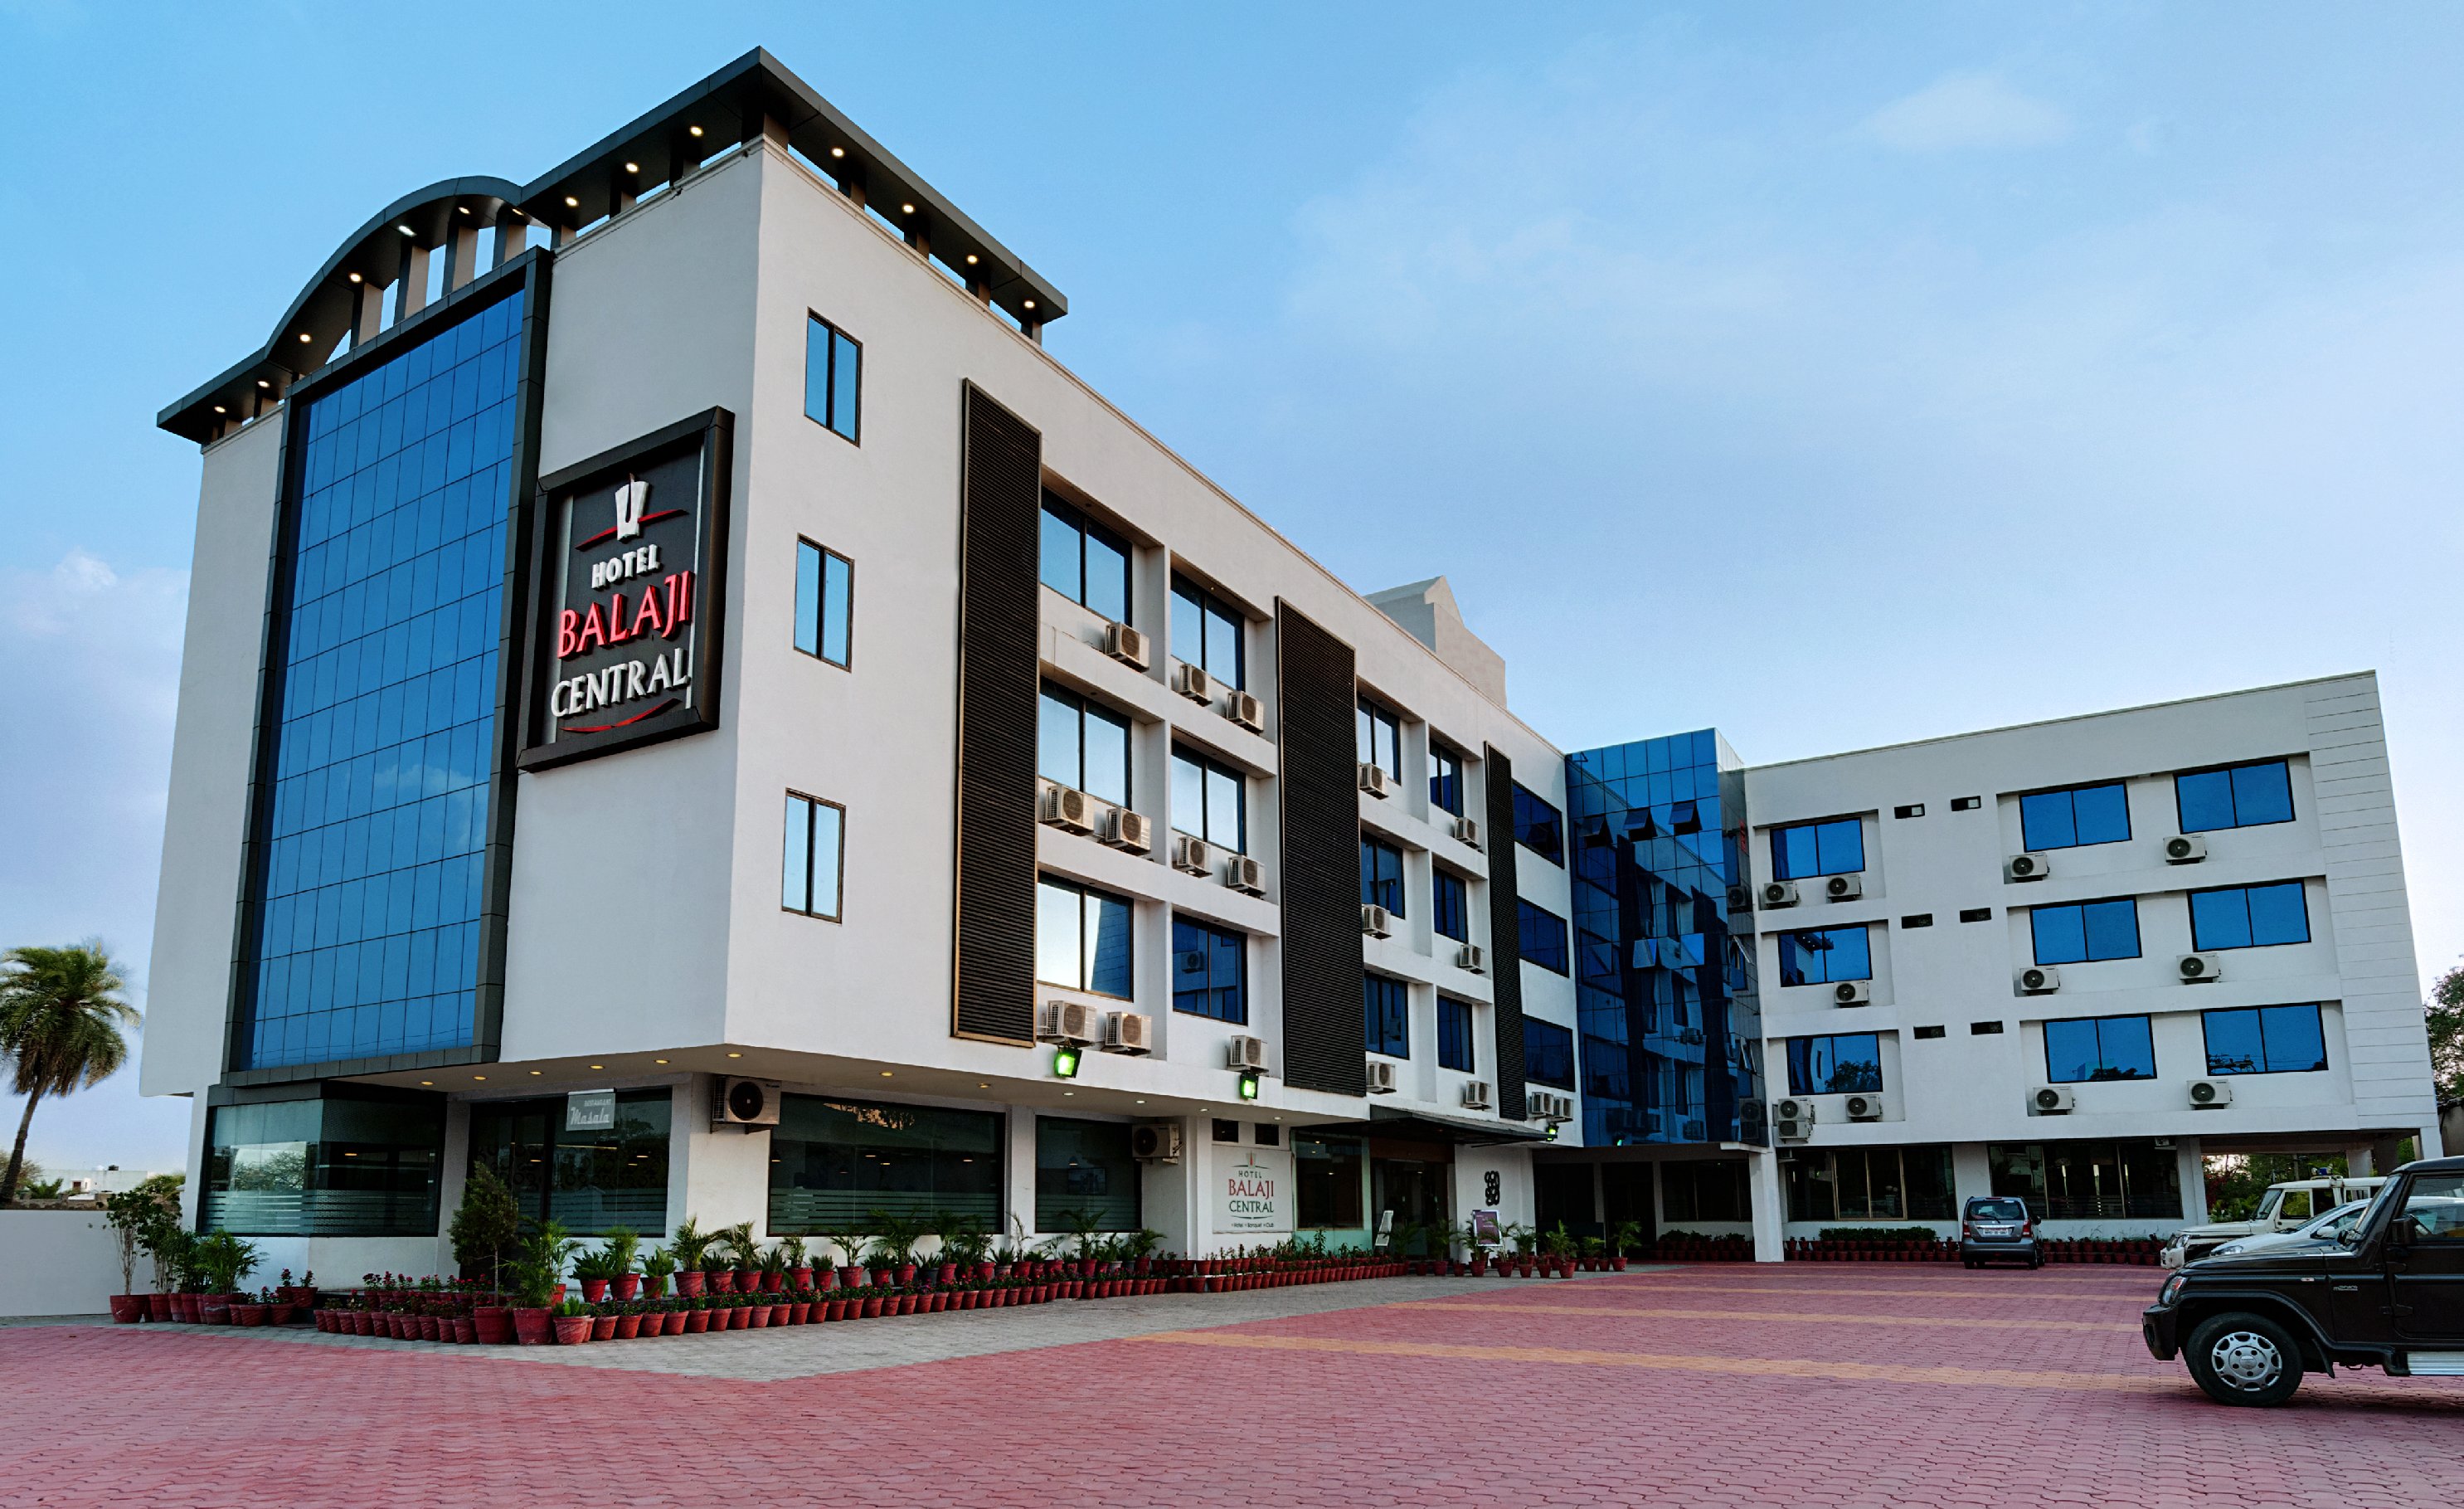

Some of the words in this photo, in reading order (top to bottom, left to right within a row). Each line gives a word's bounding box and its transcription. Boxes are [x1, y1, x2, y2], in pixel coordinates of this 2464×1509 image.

[591, 544, 661, 590] HOTEL
[557, 570, 695, 660] BALAJI
[551, 648, 691, 718] CENTRAL
[570, 1107, 610, 1125] Masala
[1238, 1171, 1262, 1179] HOTEL
[1228, 1179, 1274, 1200] BALAJI
[1229, 1200, 1275, 1213] CENTRAL
